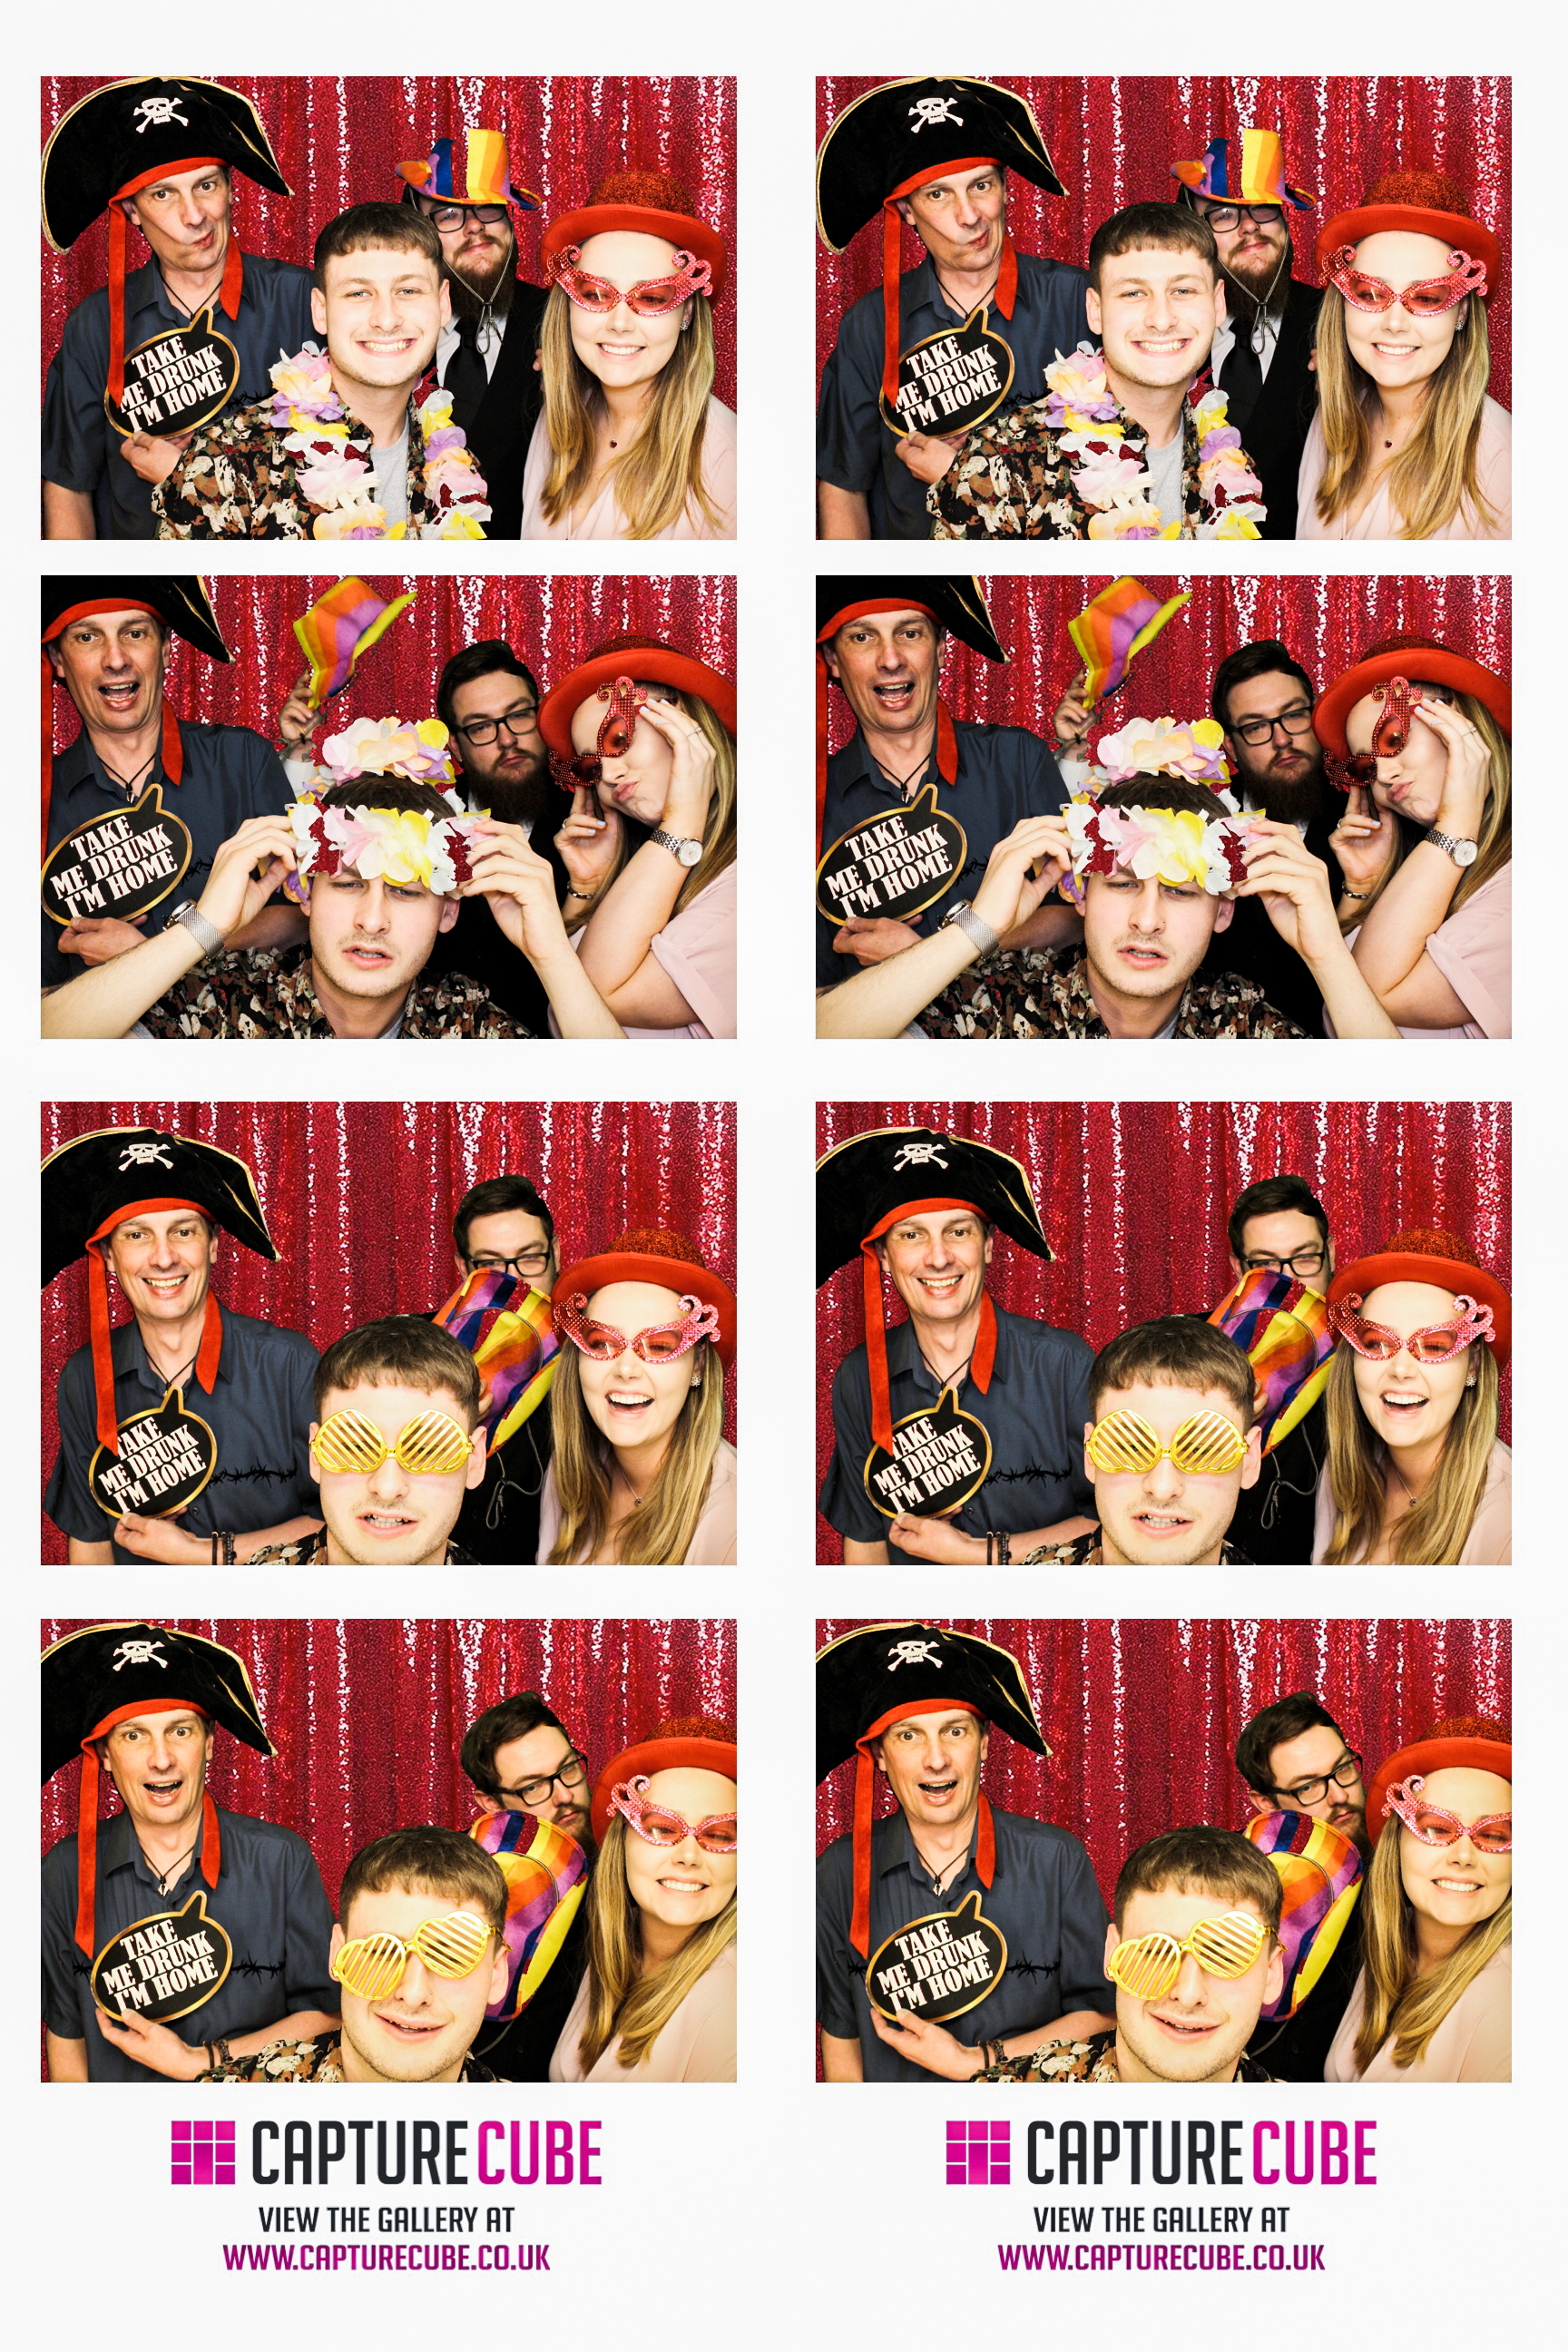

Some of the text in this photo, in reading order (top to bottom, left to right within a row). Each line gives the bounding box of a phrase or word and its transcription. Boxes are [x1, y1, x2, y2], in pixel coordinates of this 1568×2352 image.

[131, 335, 187, 378] TAKE
[147, 344, 222, 397] DRUNK
[906, 335, 962, 378] TAKE
[922, 344, 997, 397] DRUNK
[126, 368, 227, 433] I'M HOME
[901, 368, 1002, 433] I'M HOME
[50, 823, 173, 900] ME DRUNK
[70, 815, 133, 862] TAKE
[825, 823, 948, 900] ME DRUNK
[845, 815, 908, 862] TAKE
[64, 848, 178, 918] I'M HOME
[839, 848, 953, 918] I'M HOME
[98, 1424, 199, 1495] ME DRUNK
[113, 1447, 207, 1514] I'M HOME
[873, 1424, 974, 1495] ME DRUNK
[888, 1447, 982, 1514] I'M HOME
[102, 1930, 215, 1994] ME DRUNK
[119, 1919, 178, 1961] TAKE
[877, 1930, 990, 1994] ME DRUNK
[894, 1919, 953, 1961] TAKE
[113, 1955, 219, 2013] I'M HOME
[888, 1955, 994, 2013] I'M HOME
